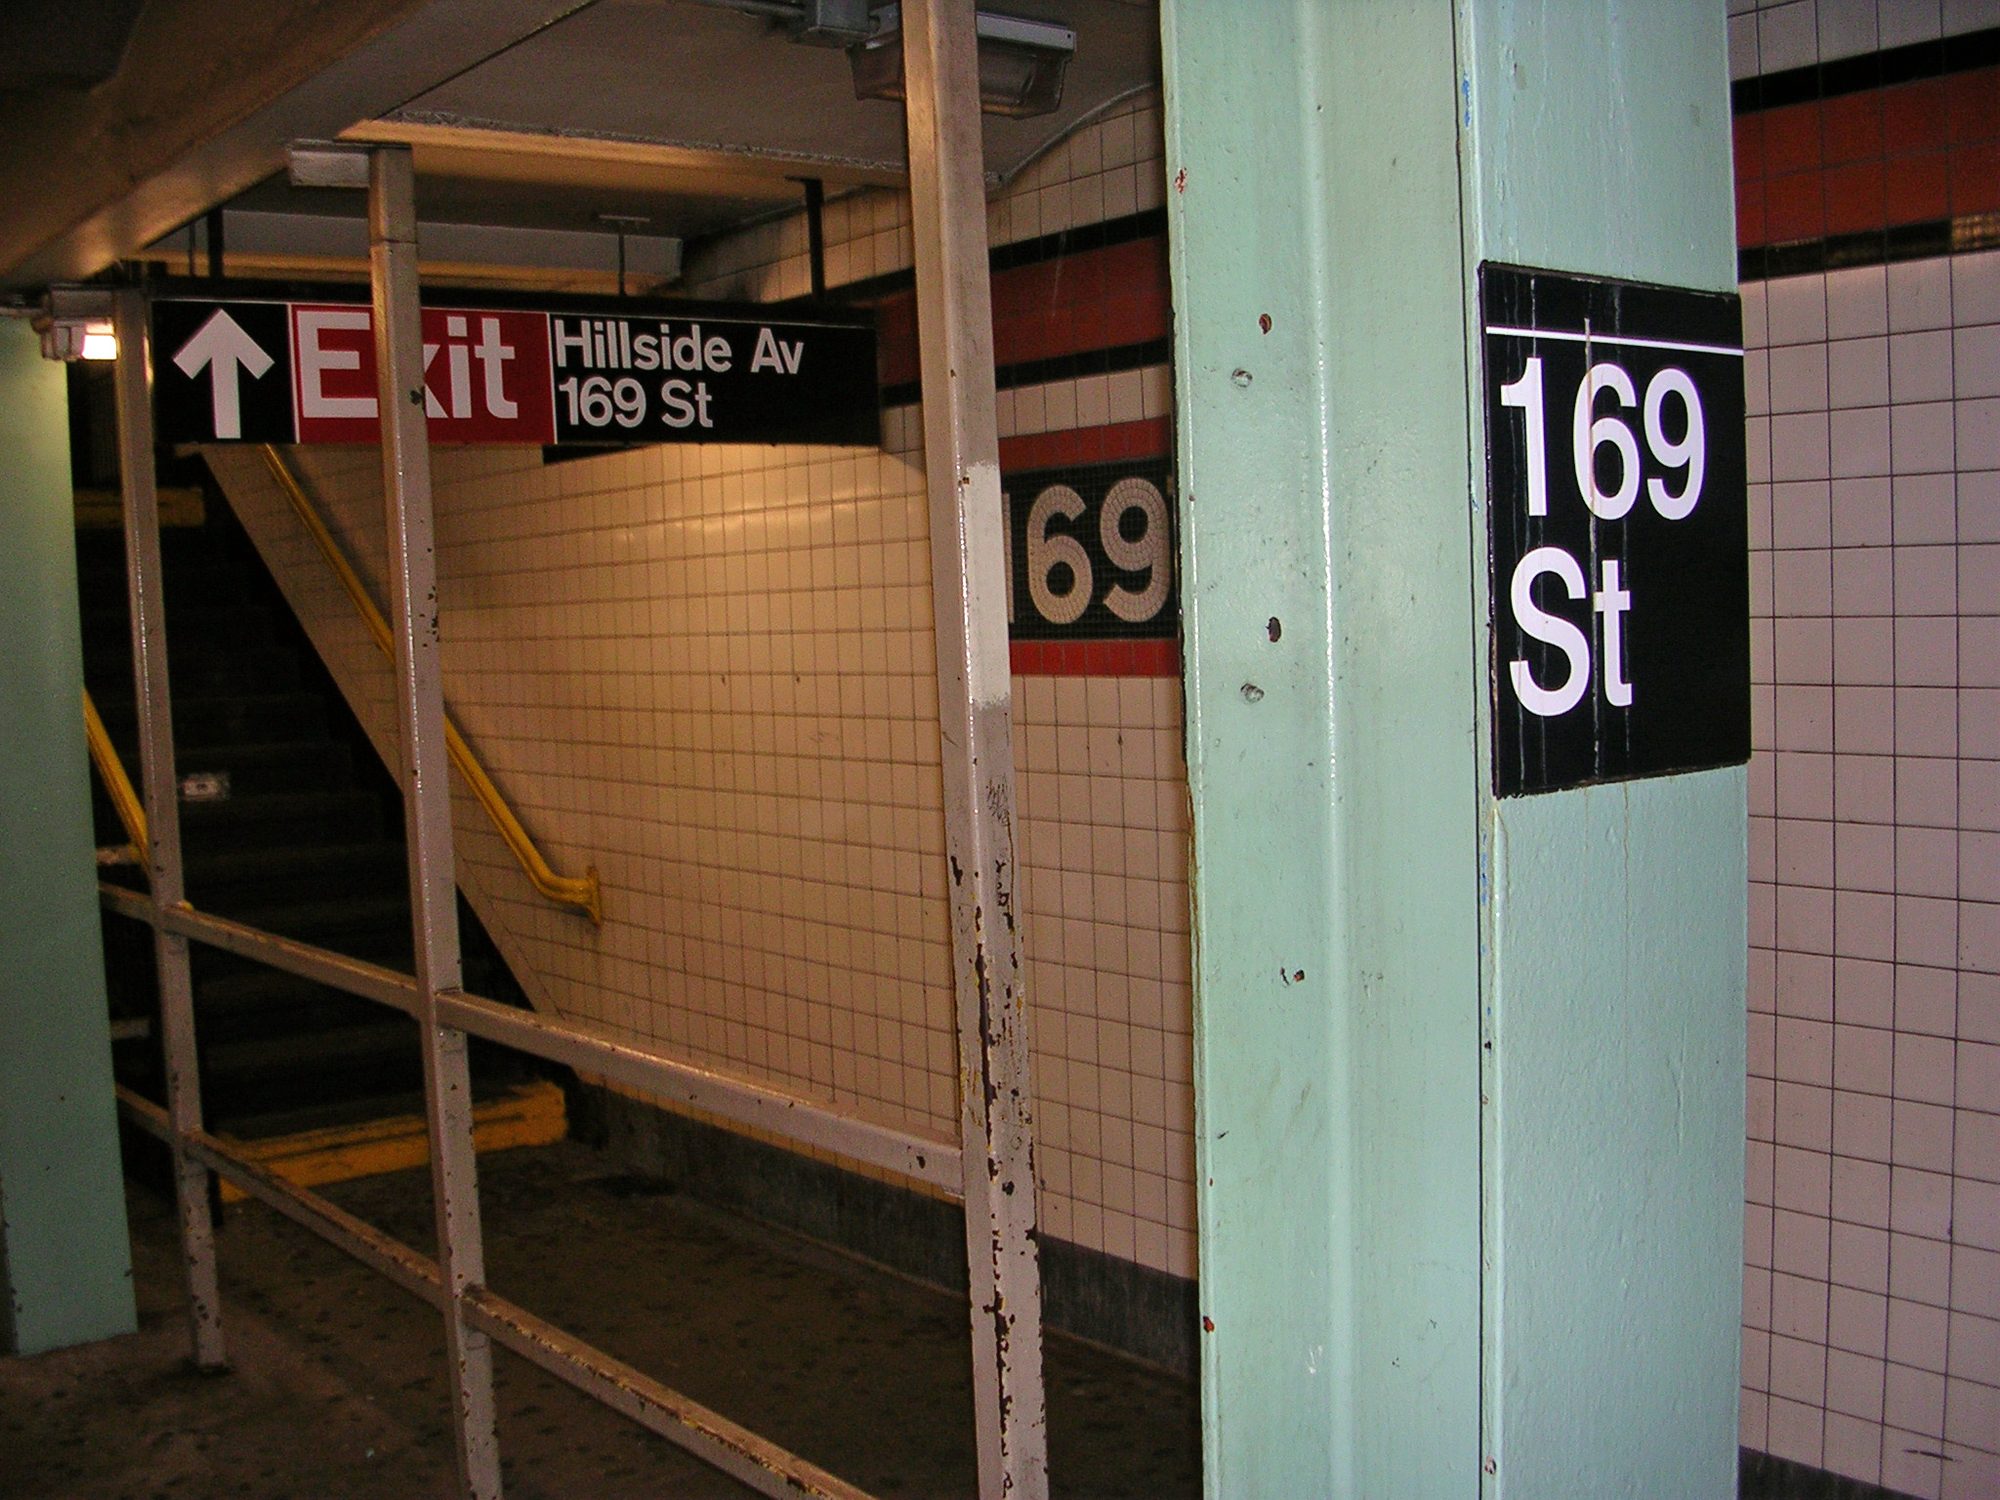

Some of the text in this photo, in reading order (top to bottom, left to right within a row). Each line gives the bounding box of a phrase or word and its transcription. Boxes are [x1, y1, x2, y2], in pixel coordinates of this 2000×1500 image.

[554, 319, 804, 375] Hillside Av
[558, 376, 714, 428] 169 St
[1500, 356, 1706, 717] 169 St
